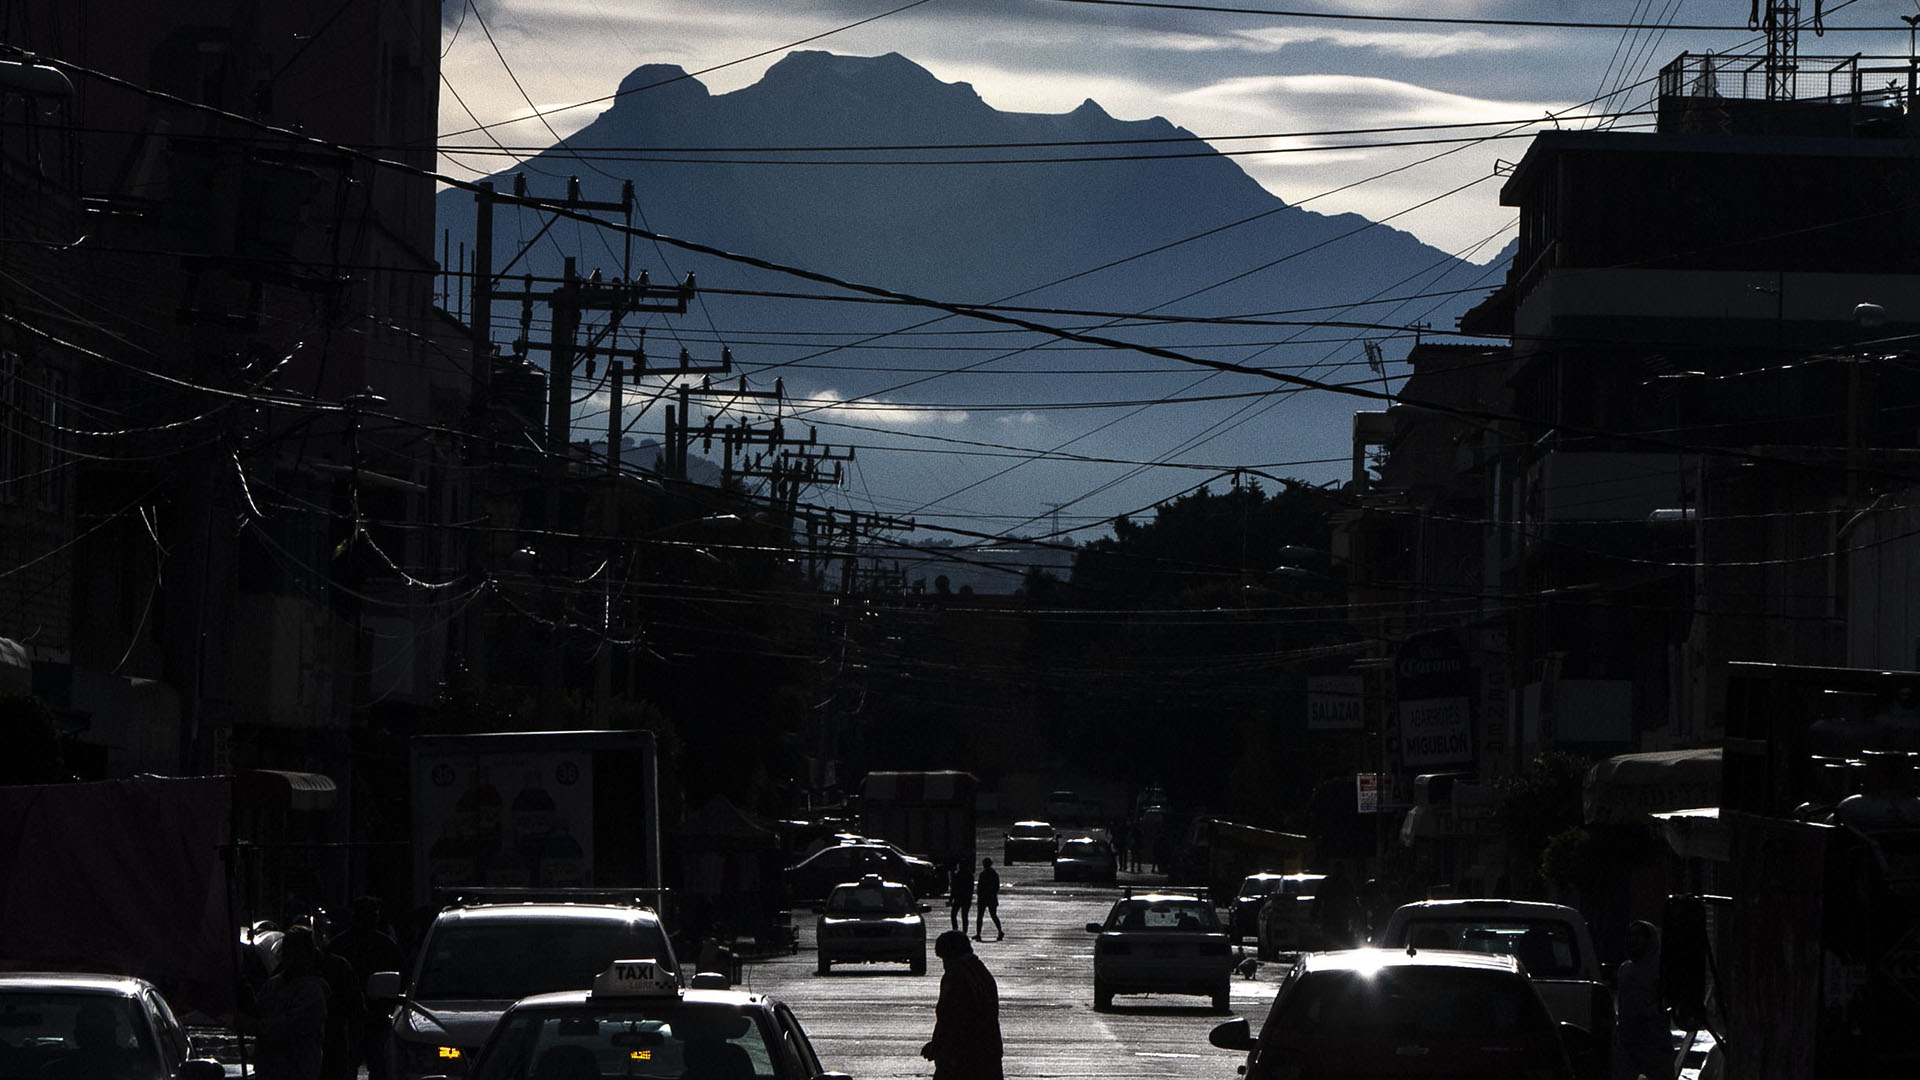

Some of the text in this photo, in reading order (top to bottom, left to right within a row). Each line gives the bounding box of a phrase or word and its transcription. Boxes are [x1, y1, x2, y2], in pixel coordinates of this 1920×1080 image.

[1312, 702, 1361, 722] SALAZAR
[1406, 731, 1468, 757] MIGUELÓN
[615, 965, 654, 980] TAXI
